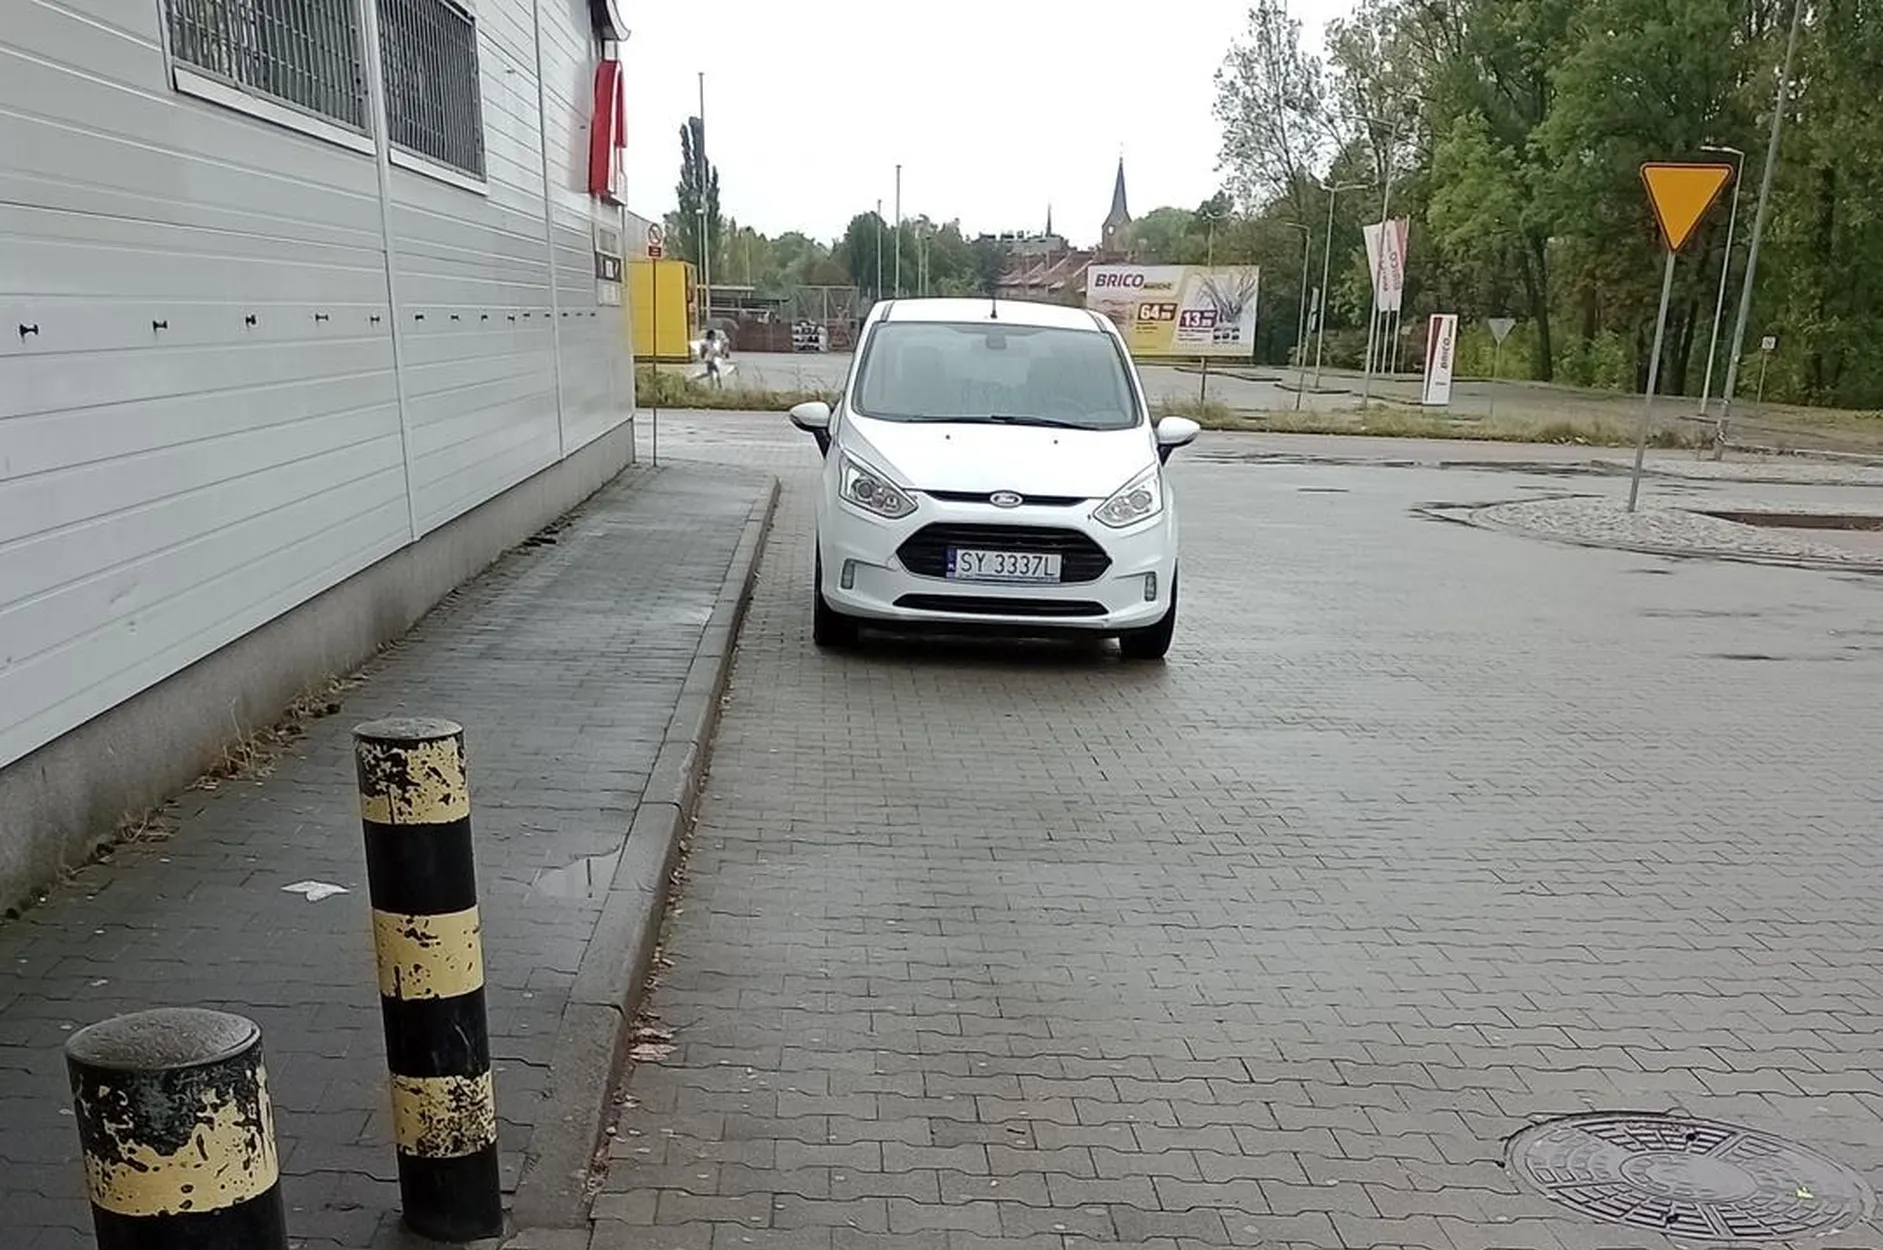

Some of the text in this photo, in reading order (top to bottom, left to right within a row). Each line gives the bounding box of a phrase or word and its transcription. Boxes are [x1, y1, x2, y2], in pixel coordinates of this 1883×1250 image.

[1094, 273, 1144, 289] BRICO
[1140, 304, 1160, 320] 64
[1183, 311, 1201, 327] 13
[960, 551, 1056, 576] SY 3337L
